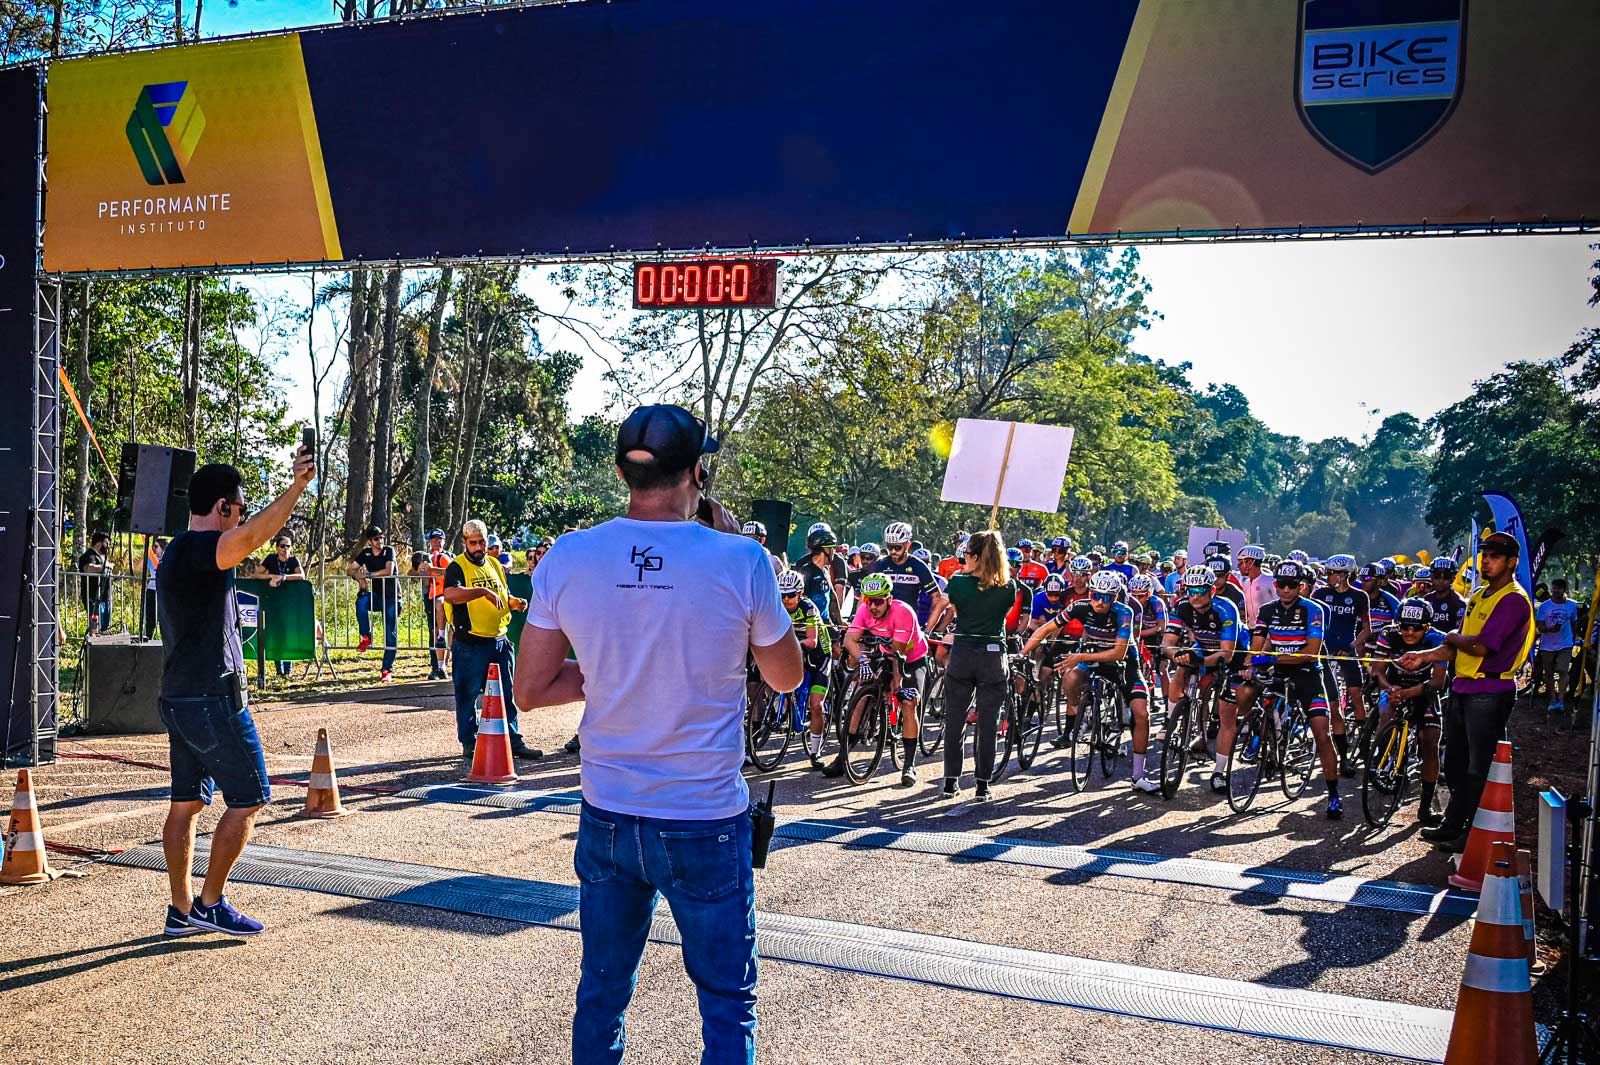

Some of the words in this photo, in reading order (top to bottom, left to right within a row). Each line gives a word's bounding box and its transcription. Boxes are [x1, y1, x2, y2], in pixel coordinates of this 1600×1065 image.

[1313, 37, 1448, 70] BIKE
[98, 193, 231, 219] PERFORMANTE
[120, 219, 205, 235] INSTITUTO
[1329, 605, 1355, 615] arget
